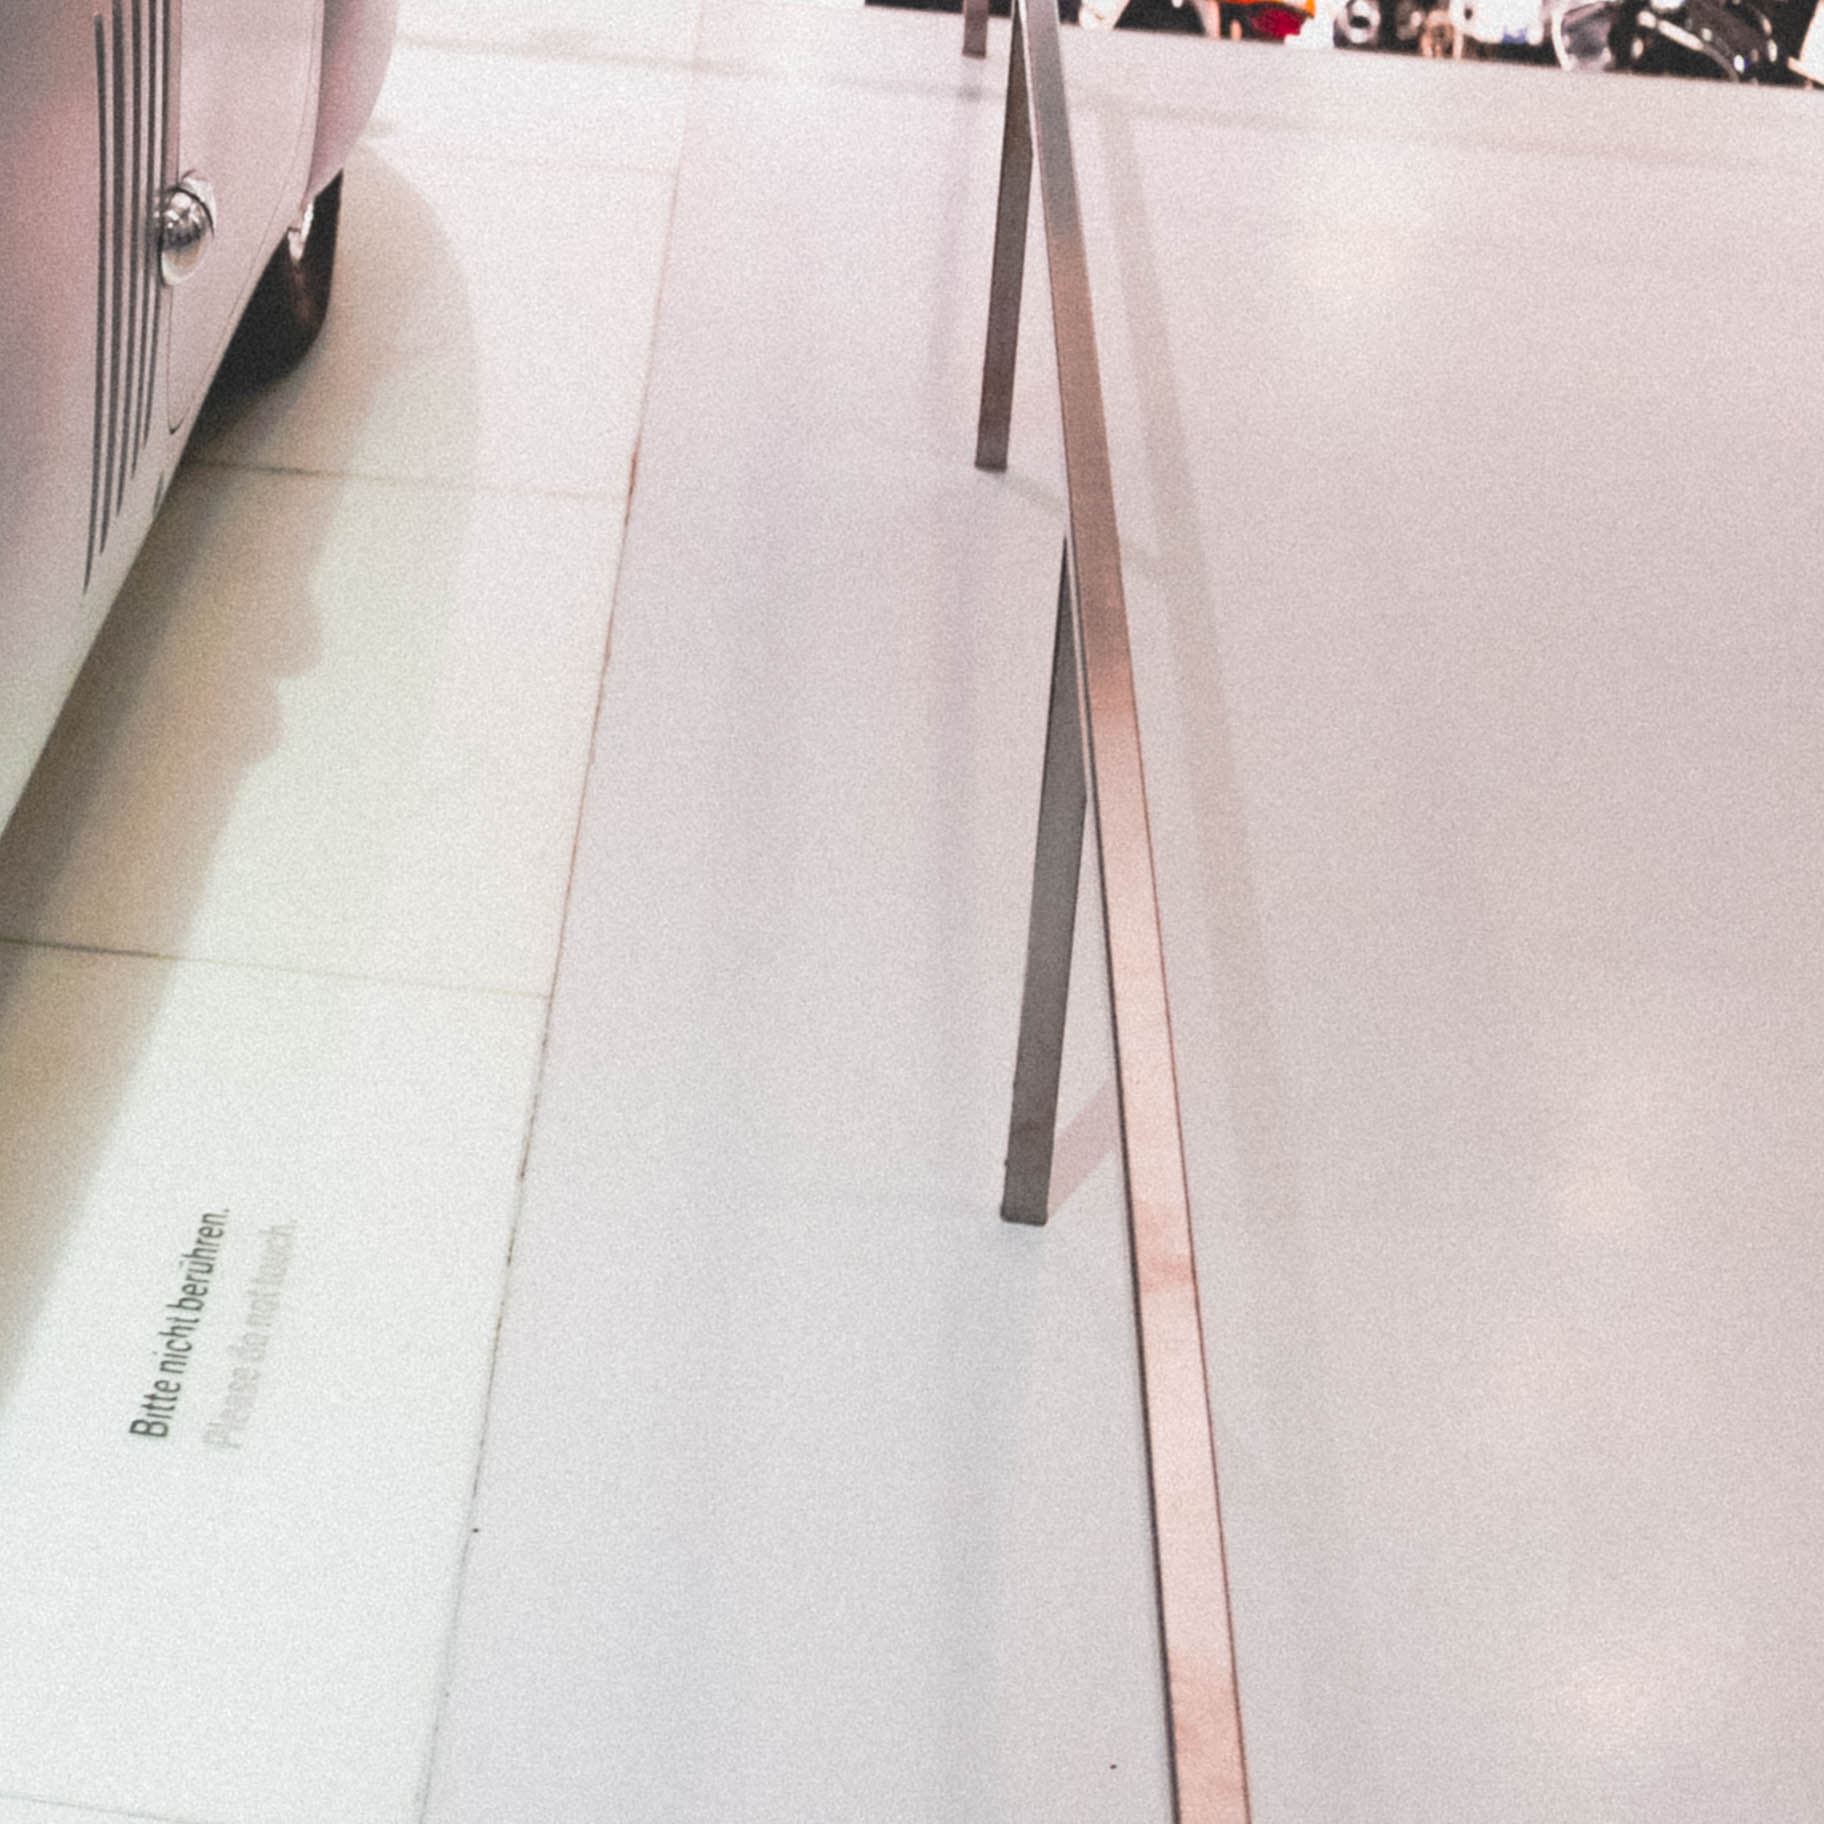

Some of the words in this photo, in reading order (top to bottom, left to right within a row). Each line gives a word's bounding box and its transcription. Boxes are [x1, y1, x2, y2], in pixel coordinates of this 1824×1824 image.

[165, 1207, 231, 1313] berühren.
[151, 1315, 201, 1376] nicht
[128, 1379, 182, 1439] Bitte
